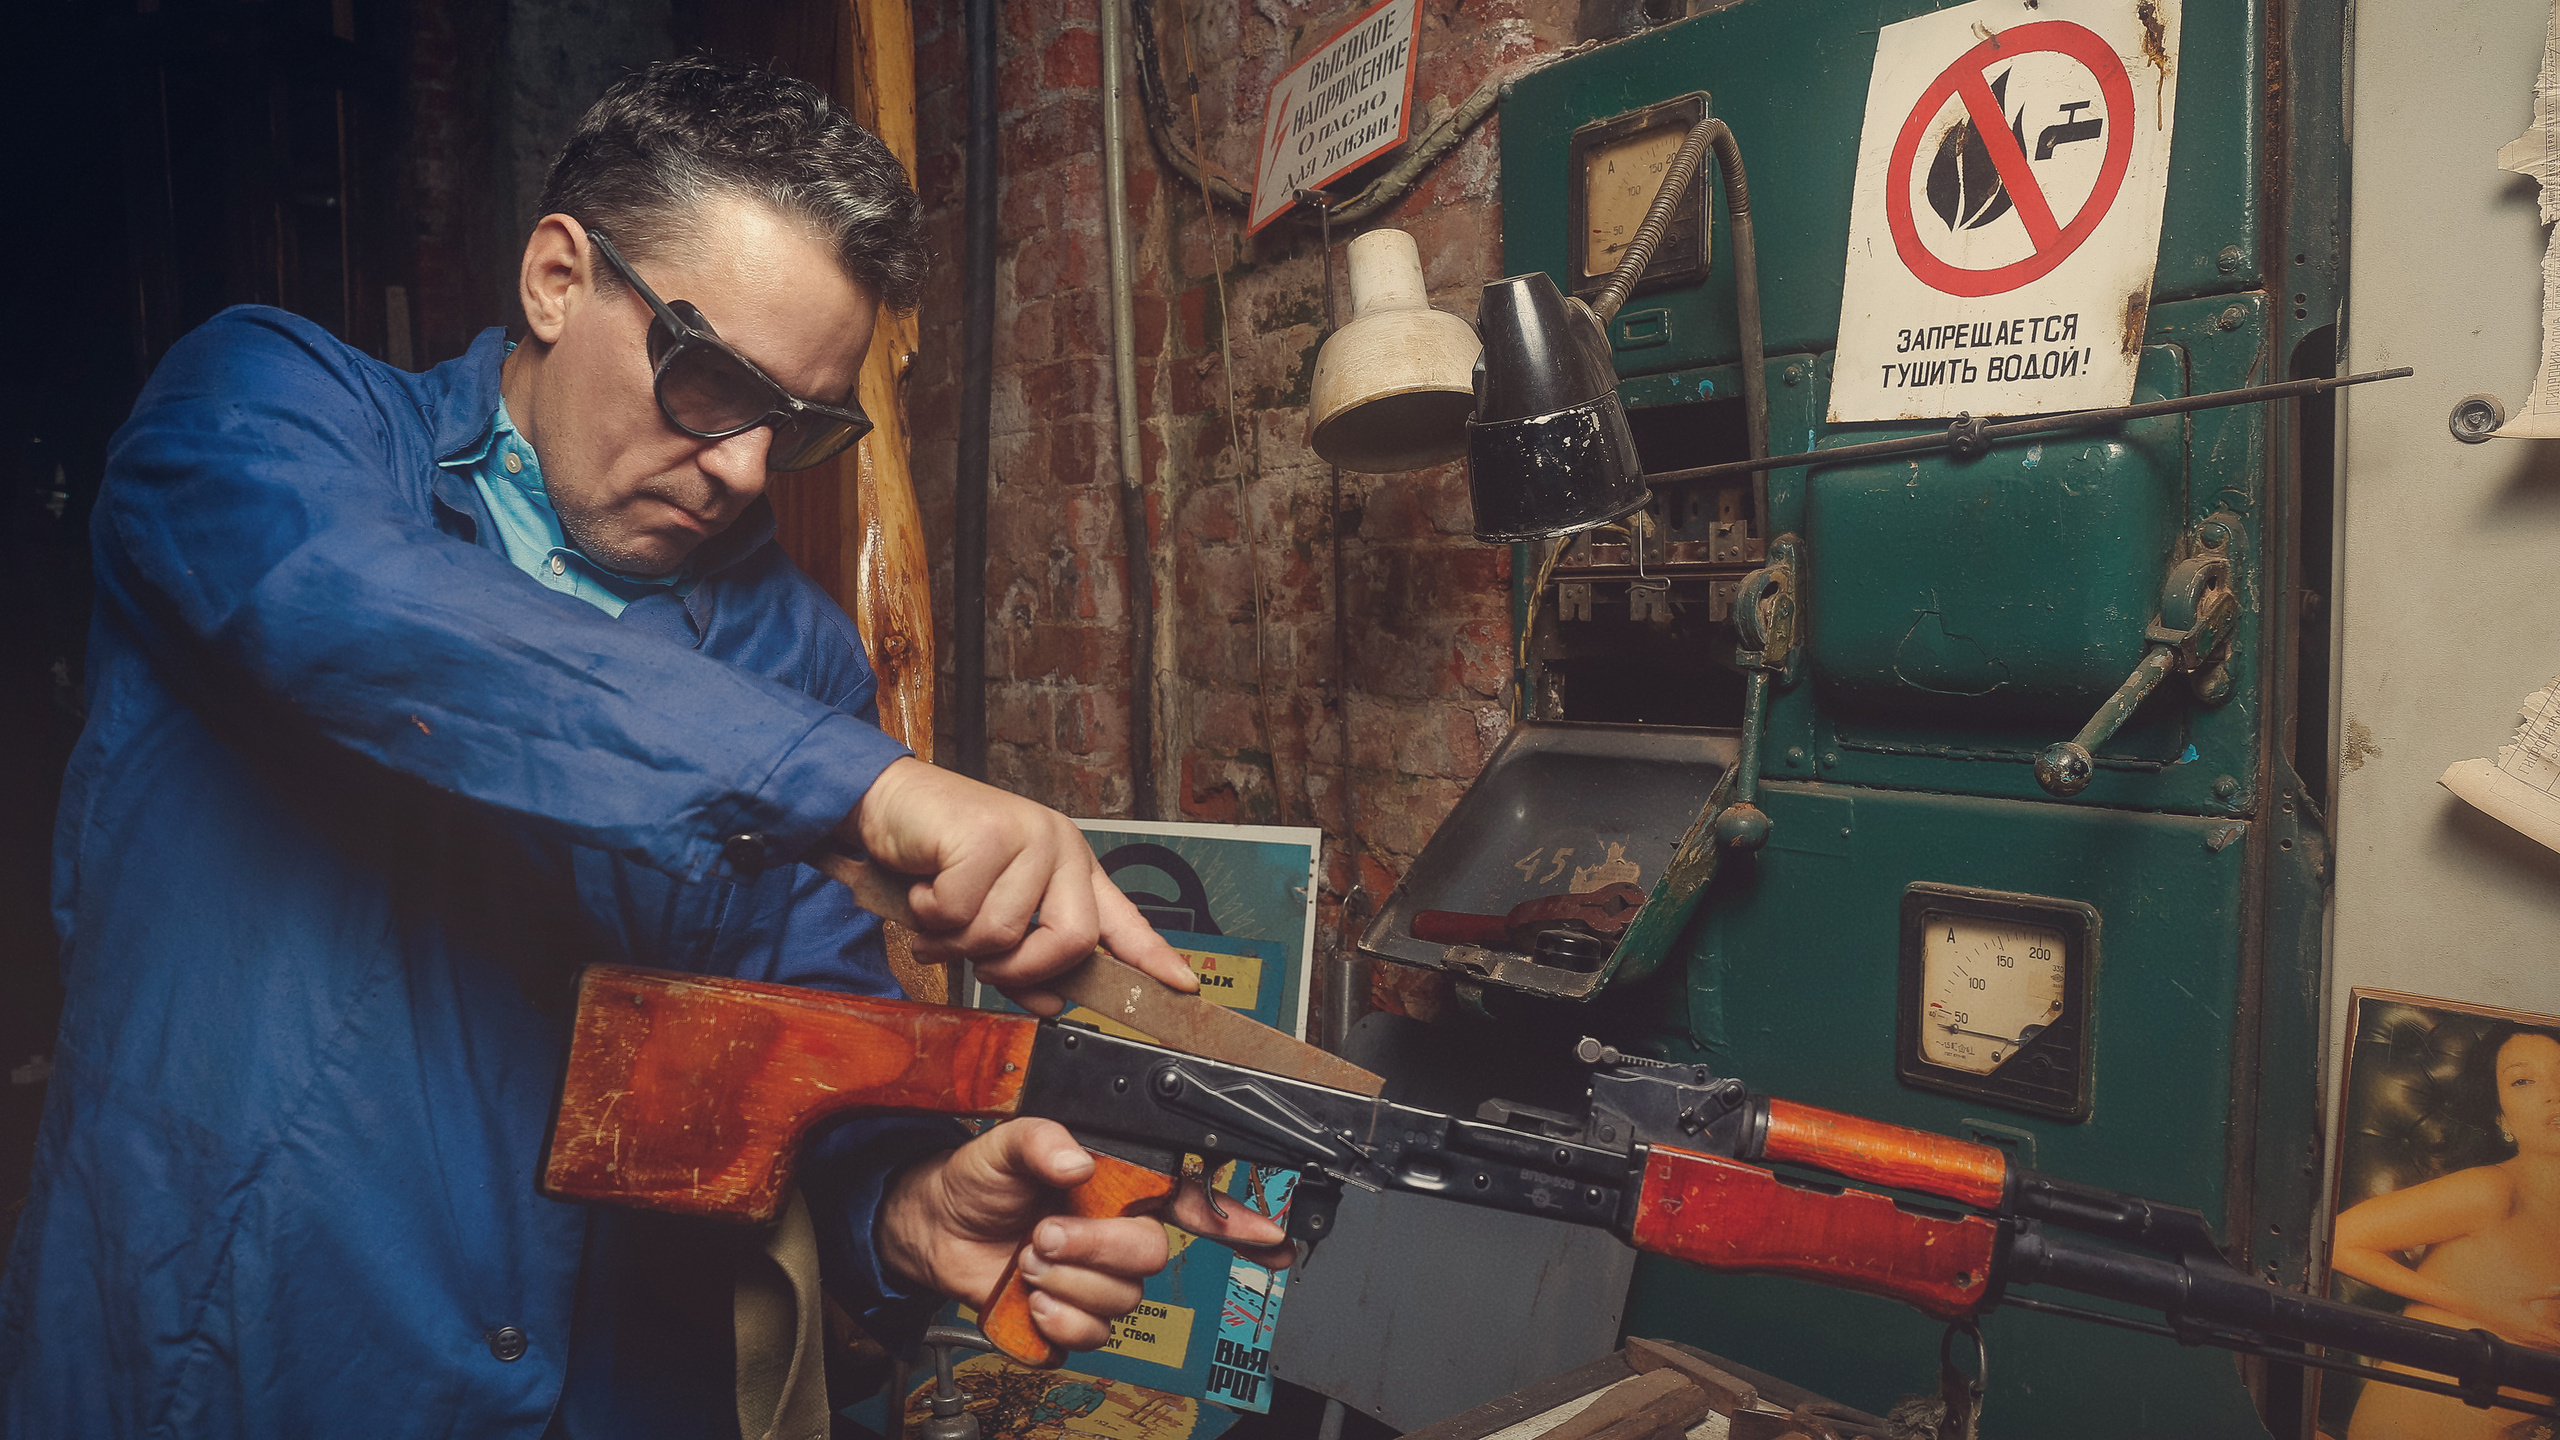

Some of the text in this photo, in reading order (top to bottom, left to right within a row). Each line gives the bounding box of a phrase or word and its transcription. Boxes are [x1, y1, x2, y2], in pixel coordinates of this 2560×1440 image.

[1292, 36, 1409, 137] НАПРЯЖЕНИЕ
[1298, 91, 1387, 155] ОПАСНО
[1281, 103, 1399, 197] ДЛЯ ЖИЗНИ!
[1628, 185, 1641, 196] 100
[1613, 225, 1624, 235] 50
[1897, 313, 2079, 353] ЗАПРЕЩАЕТСЯ
[1881, 347, 2092, 389] ТУШИТЬ ВОДОЙ!
[1515, 847, 1575, 885] 45
[1996, 955, 2014, 968] 150
[2029, 946, 2051, 961] 200
[1194, 972, 1234, 988] ЫХ
[1968, 977, 1986, 991] 100
[1954, 1011, 1969, 1025] 50
[1123, 1327, 1156, 1344] СТВОЛ
